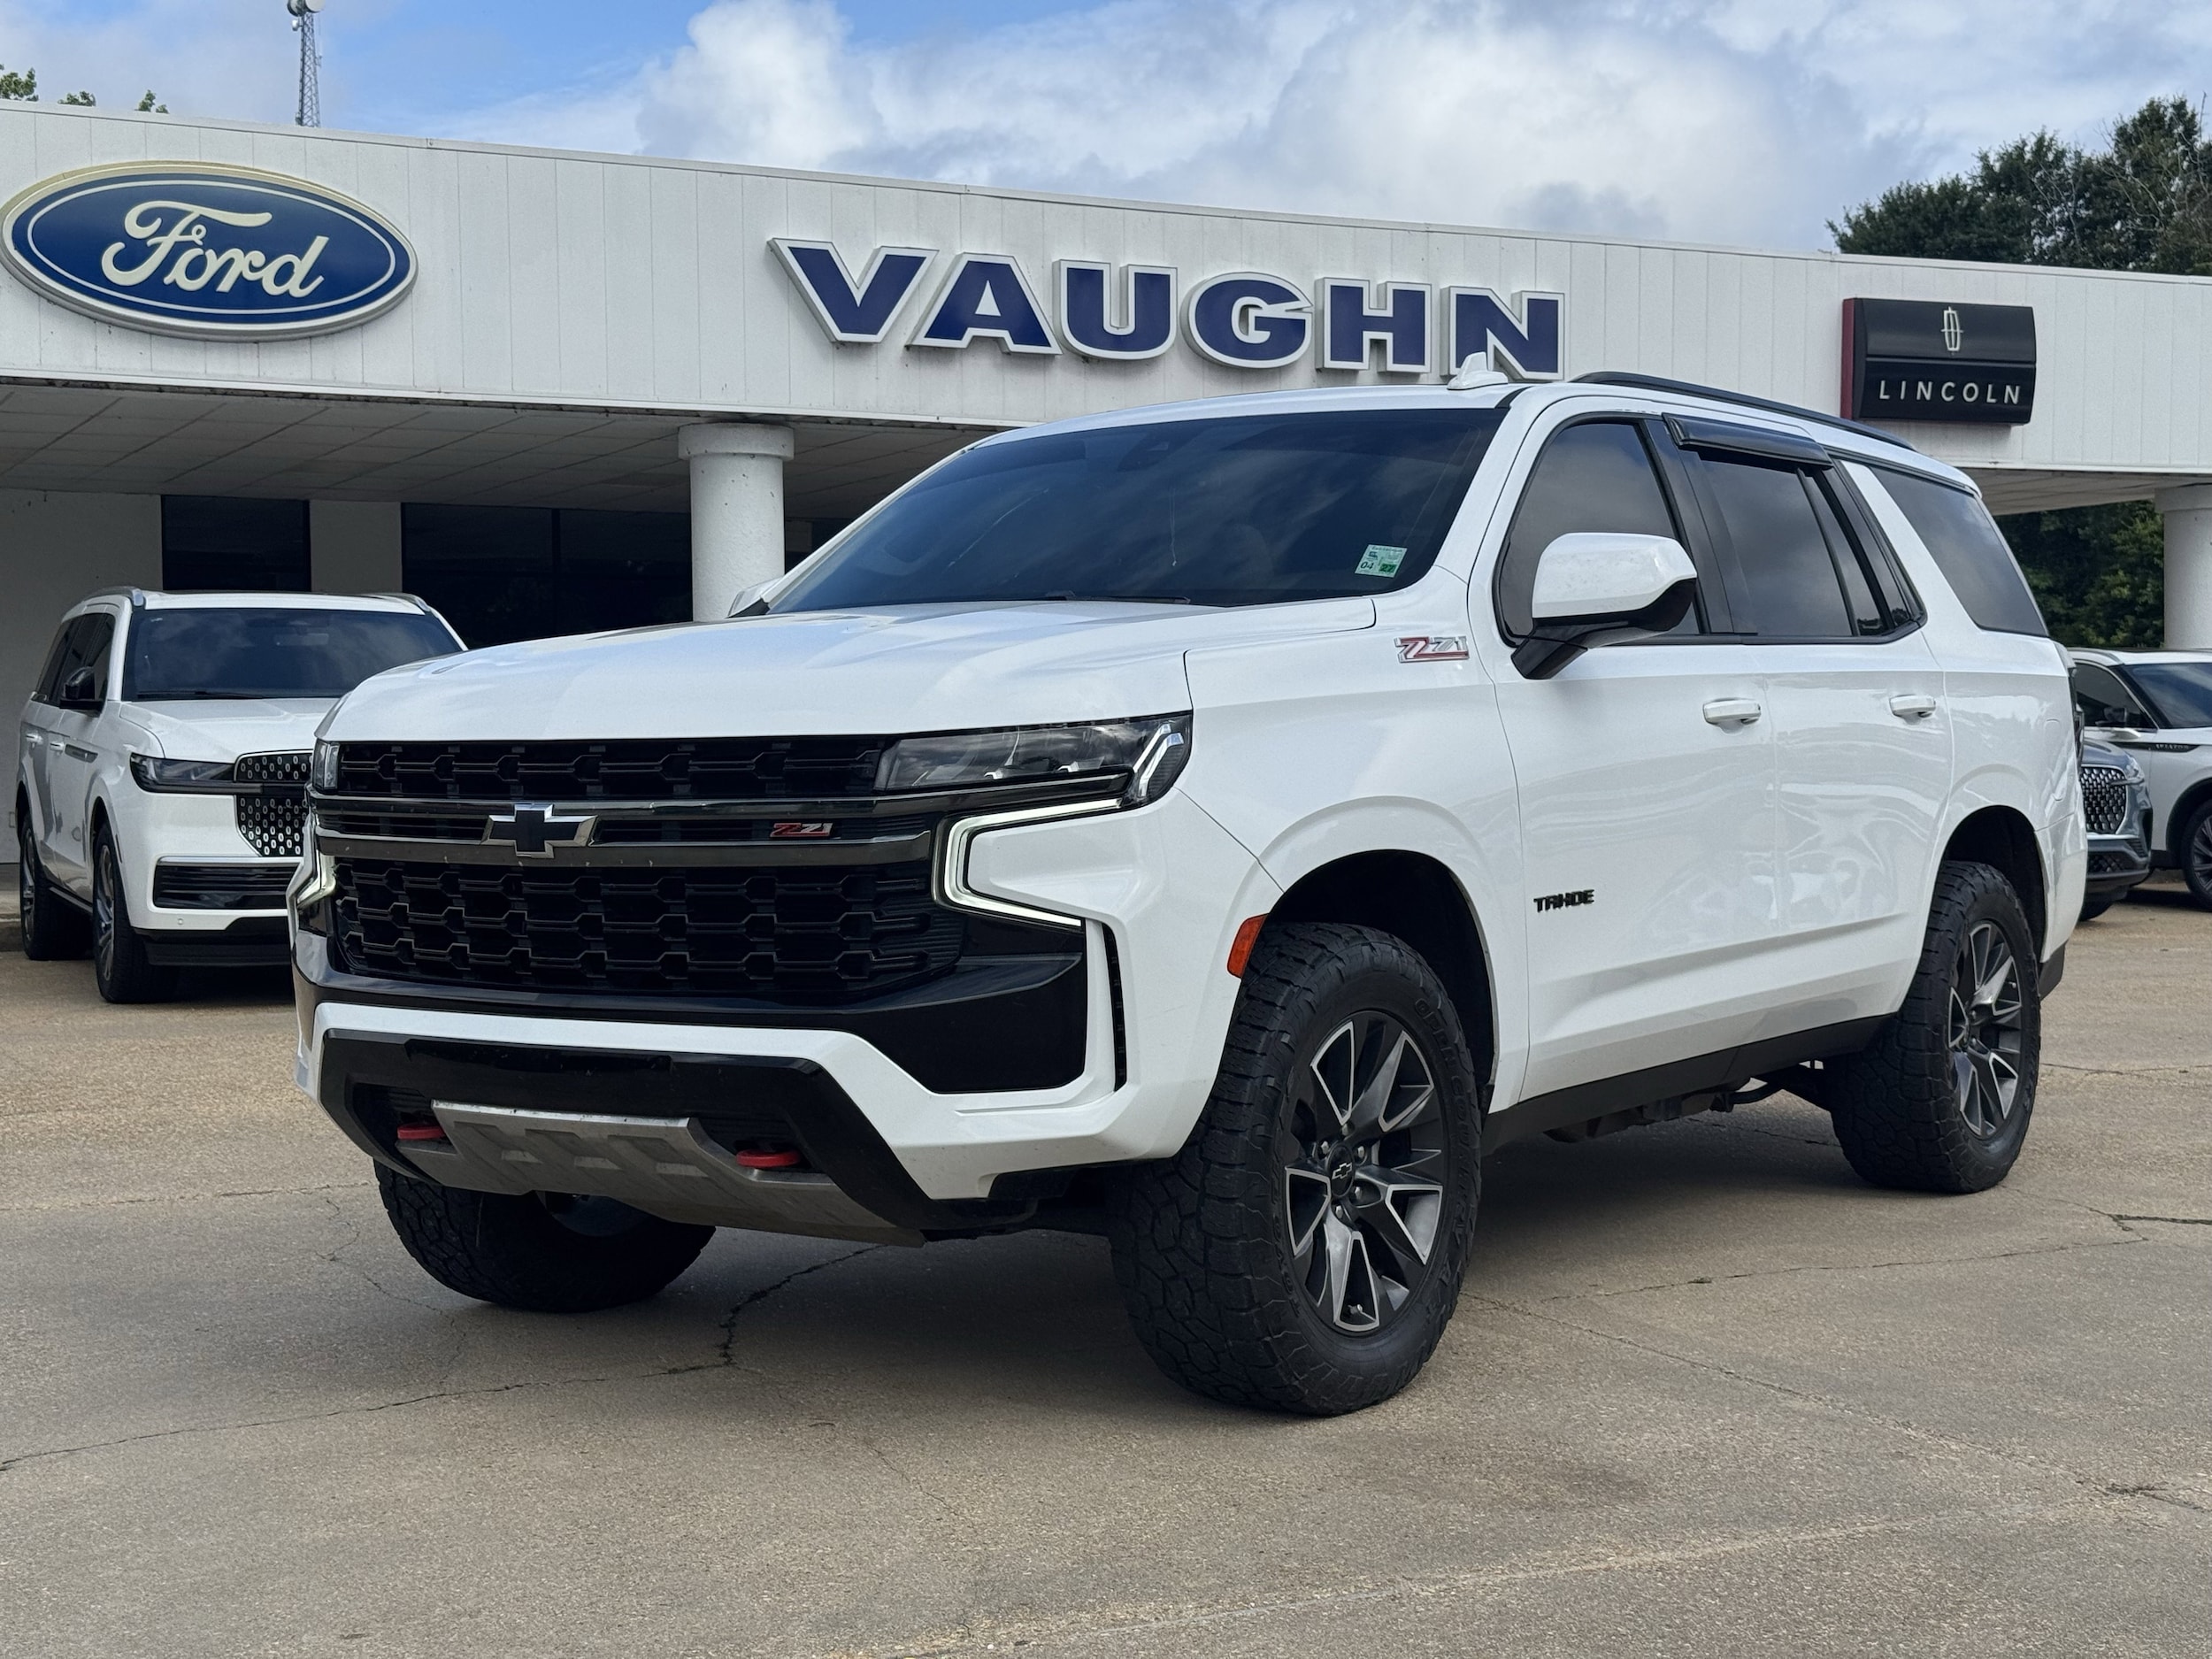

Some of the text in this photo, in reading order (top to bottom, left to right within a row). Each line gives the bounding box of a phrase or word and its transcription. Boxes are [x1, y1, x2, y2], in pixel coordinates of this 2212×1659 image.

[102, 201, 328, 297] Ford
[768, 237, 1565, 381] VAUGHN
[1879, 380, 2021, 404] LINCOLN
[1380, 564, 1396, 572] 27
[1394, 636, 1470, 663] Z71
[770, 822, 833, 838] Z71
[1533, 888, 1594, 913] TAHOE
